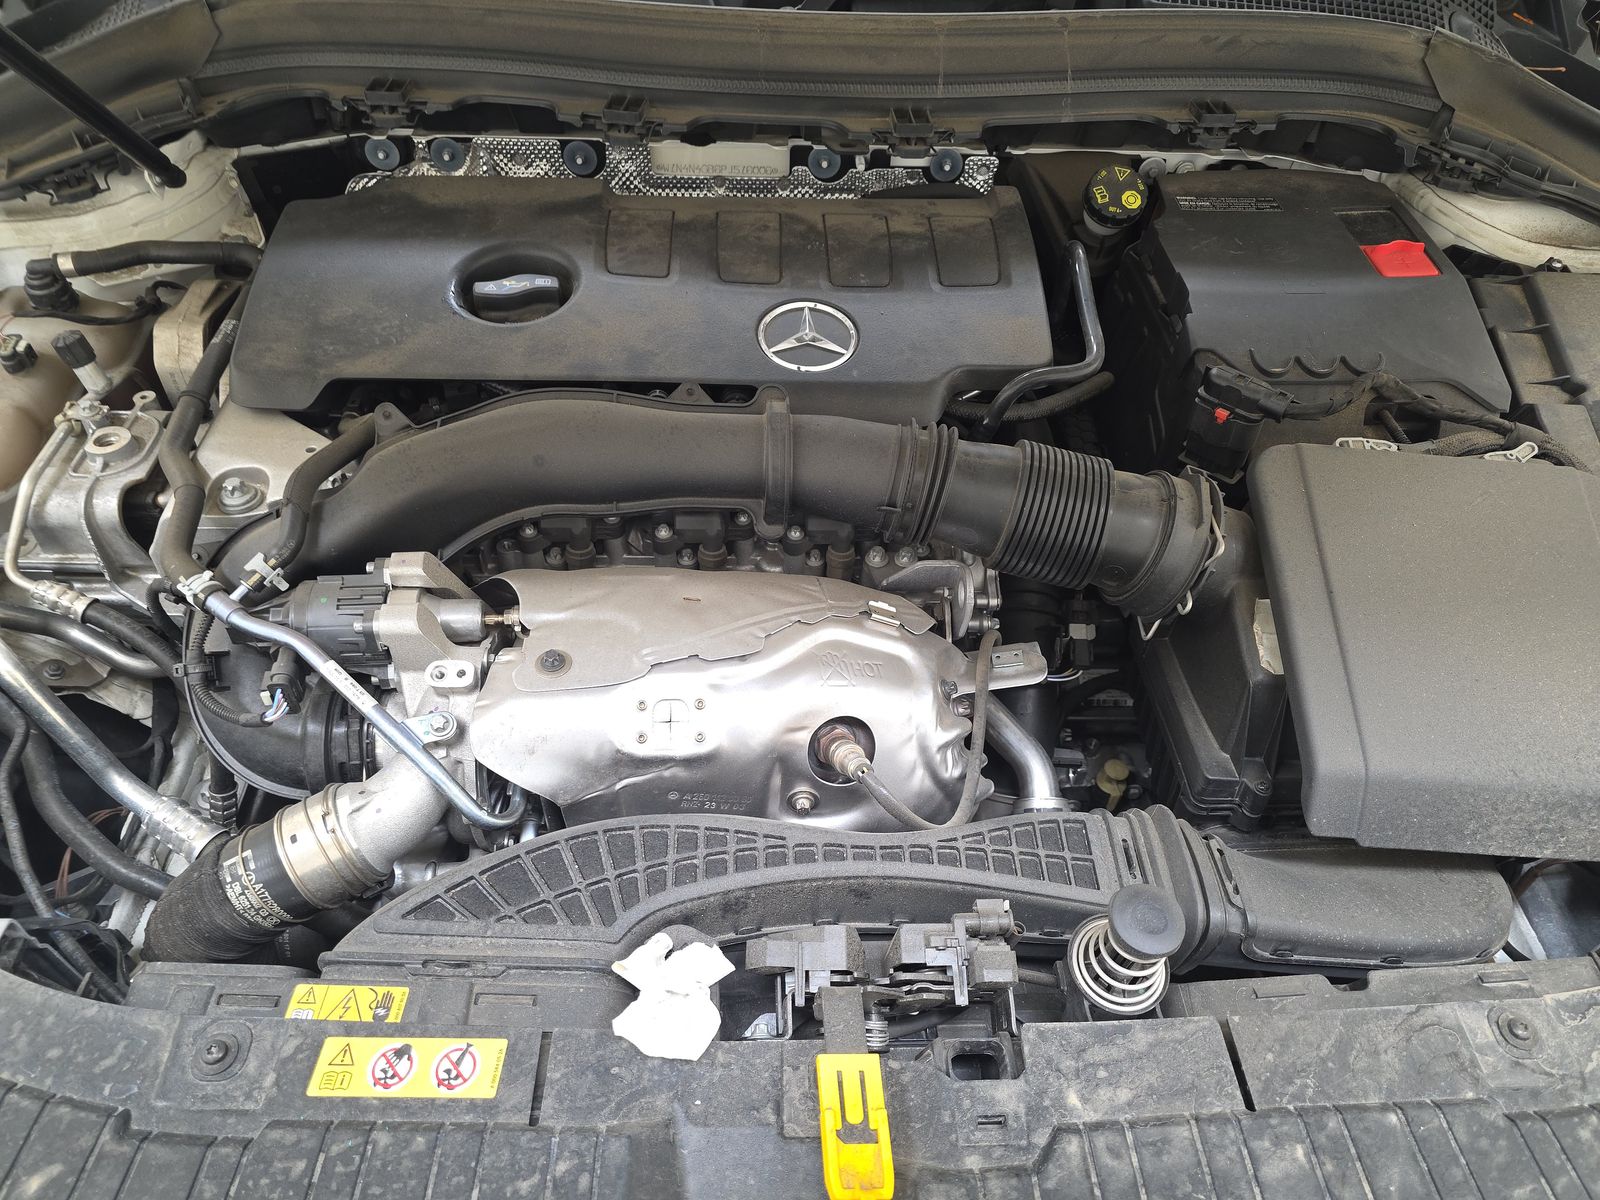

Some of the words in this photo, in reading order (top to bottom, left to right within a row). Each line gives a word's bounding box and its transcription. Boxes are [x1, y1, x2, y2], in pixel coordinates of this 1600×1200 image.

[850, 660, 882, 678] HOT
[704, 801, 716, 809] 23
[231, 882, 242, 897] DBL
